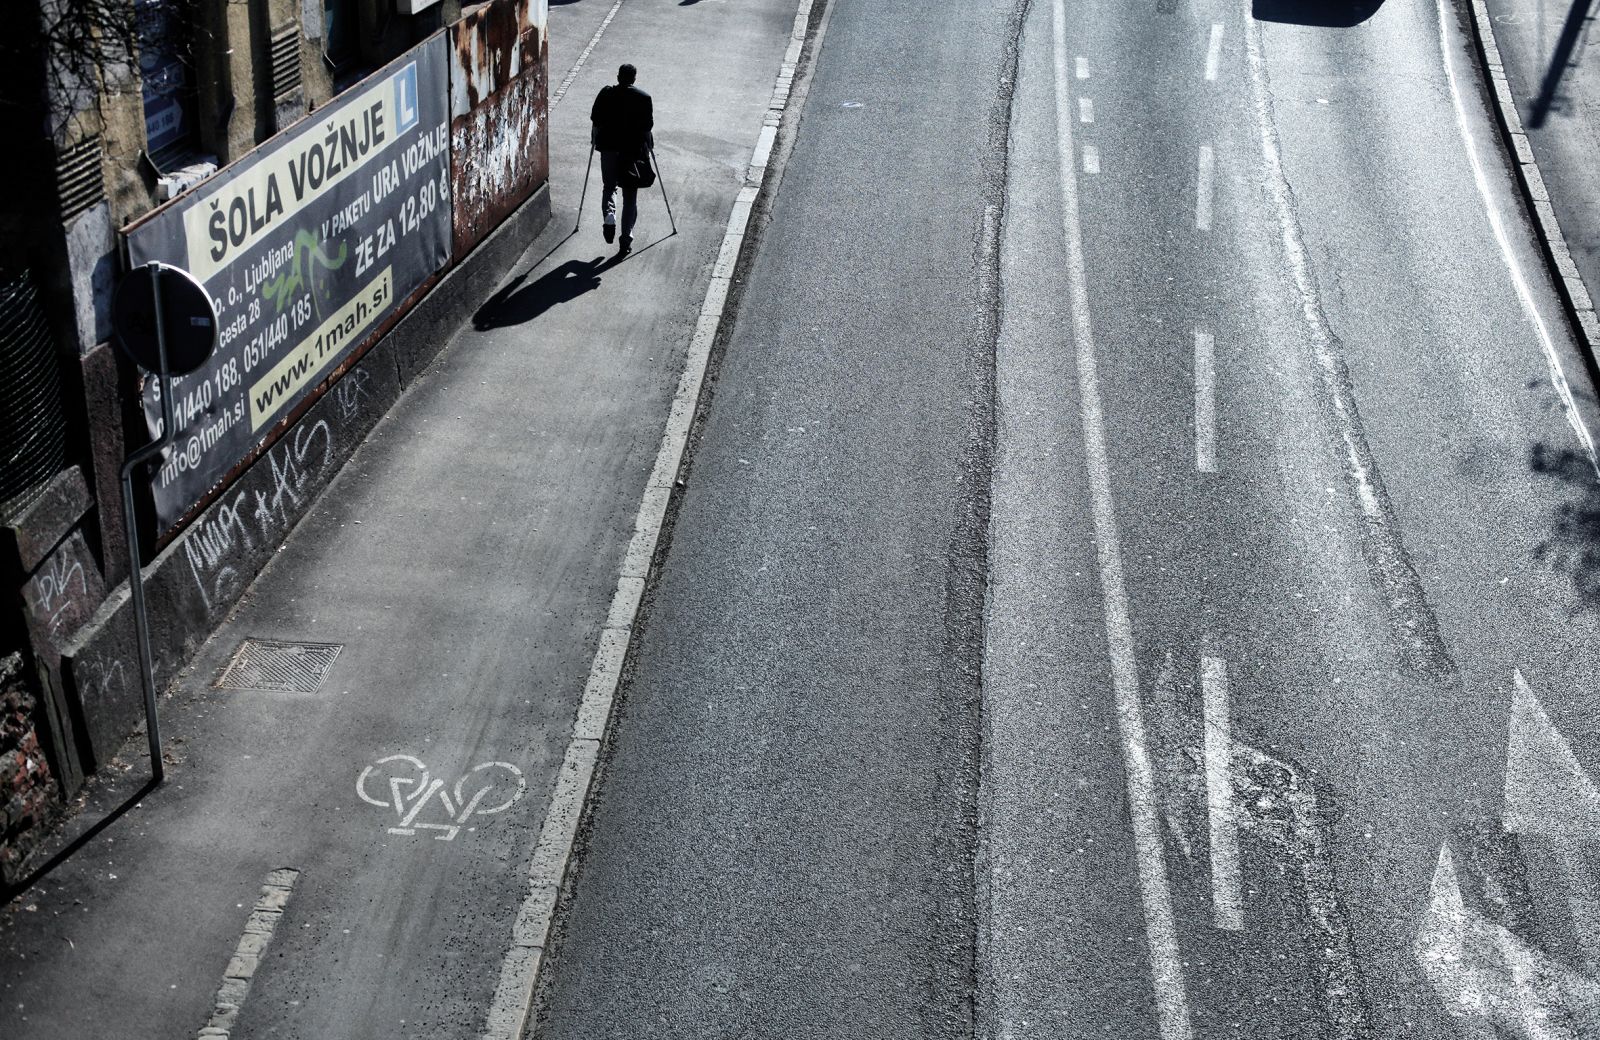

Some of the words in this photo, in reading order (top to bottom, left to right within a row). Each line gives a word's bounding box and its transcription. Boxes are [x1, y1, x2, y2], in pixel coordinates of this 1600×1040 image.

[400, 77, 415, 121] L
[208, 173, 283, 262] ŠOLA
[287, 101, 385, 201] VOŽNJE
[332, 190, 370, 237] PAKETU
[373, 160, 400, 204] URA
[402, 121, 448, 180] VOŽNJE
[355, 236, 374, 278] ŽE
[377, 218, 396, 258] ZA
[399, 178, 436, 237] 12,80
[440, 168, 449, 201] €
[219, 314, 247, 348] cesta
[248, 298, 261, 324] 28
[228, 286, 243, 306] o.,
[245, 240, 294, 294] Ljubljana
[215, 356, 242, 398] 188,
[243, 312, 288, 373] 051/440
[291, 293, 312, 331] 185
[255, 277, 388, 413] www.1mah.si
[160, 394, 245, 488] info@1mah.si
